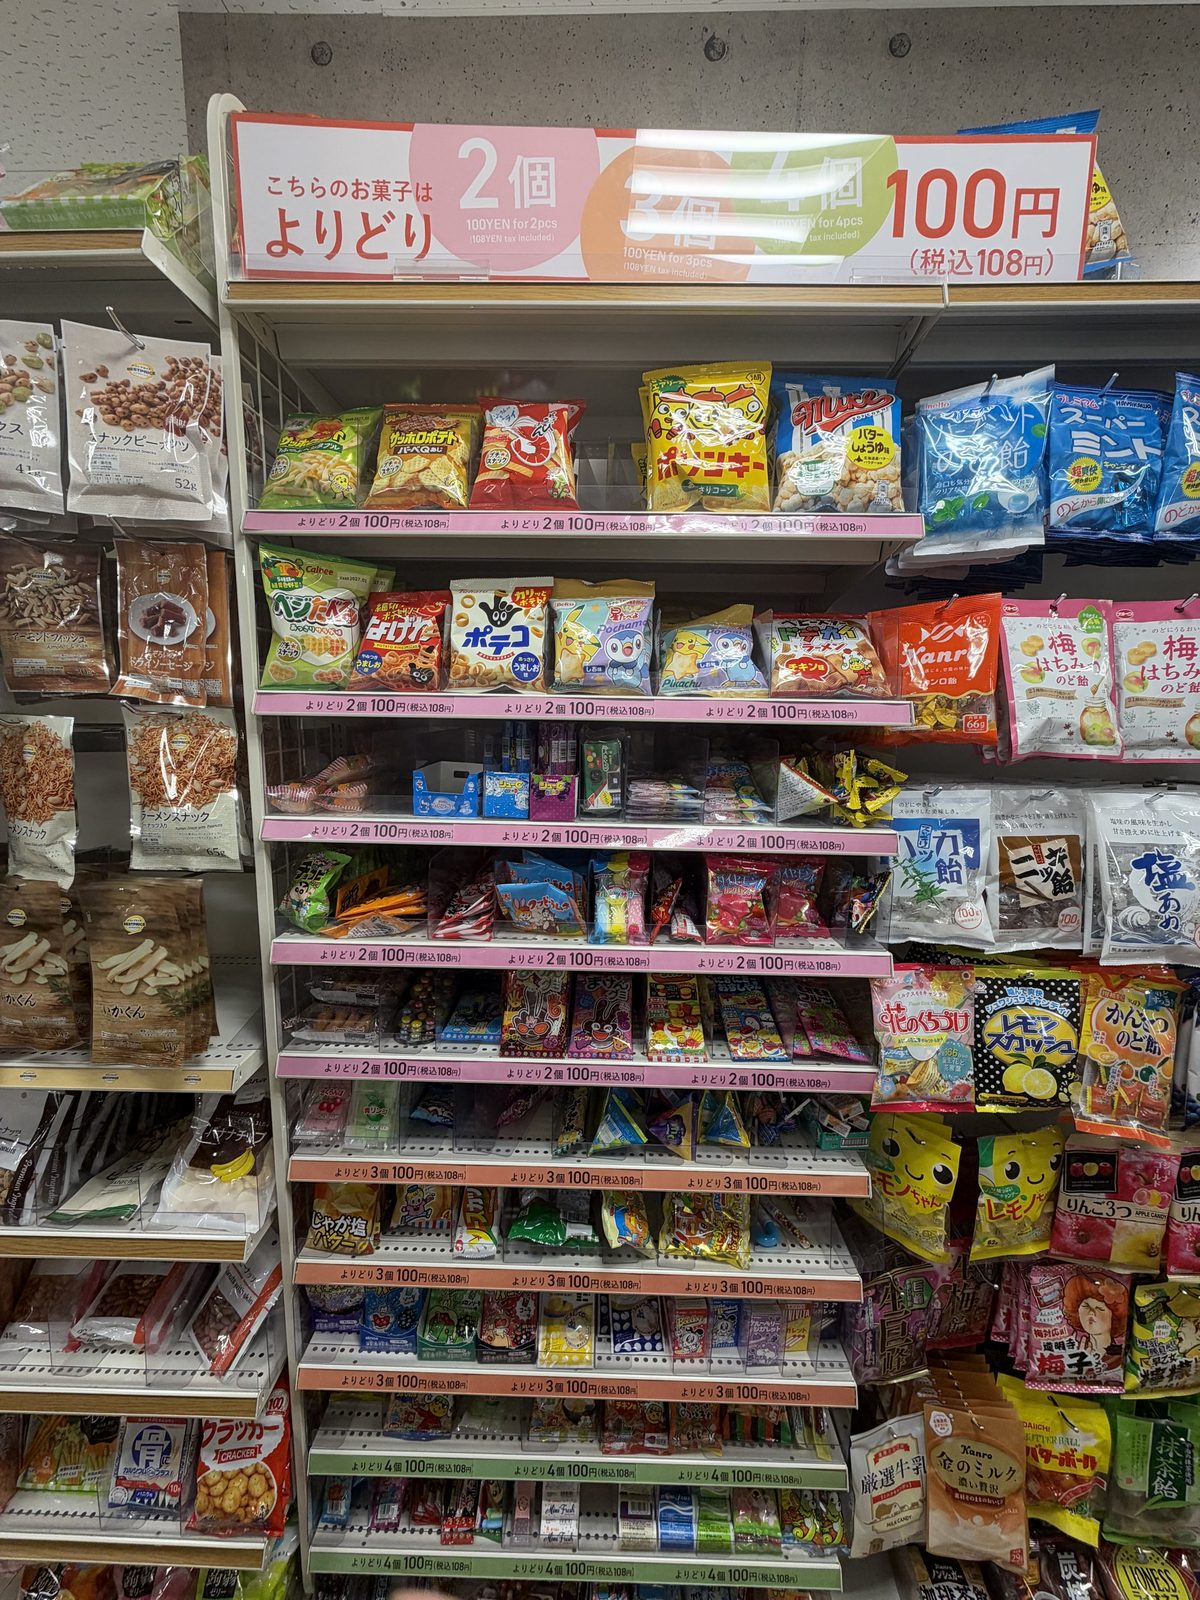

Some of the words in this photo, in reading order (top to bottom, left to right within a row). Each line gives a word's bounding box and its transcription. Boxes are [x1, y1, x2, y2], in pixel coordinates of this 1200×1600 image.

[457, 136, 558, 210] 2個
[266, 174, 433, 203] こちらのお菓子は
[620, 169, 722, 252] 3個
[885, 166, 1062, 240] 100円
[466, 218, 510, 232] 100YEN
[512, 217, 528, 230] for
[529, 217, 558, 231] 2pcs
[816, 216, 831, 229] for
[832, 214, 864, 229] 4pcs
[264, 206, 433, 262] よりどり
[503, 234, 516, 244] tax
[516, 233, 555, 245] included)
[825, 230, 861, 243] included)
[622, 246, 667, 262] 100YEN
[668, 249, 685, 264] for
[685, 252, 713, 269] 3pcs
[908, 247, 1056, 279] (税込108円)
[671, 264, 709, 279] included)
[1060, 407, 1146, 430] スーパー
[390, 431, 458, 449] サッポロポテト
[858, 428, 884, 440] バター
[1071, 430, 1162, 461] ミント
[174, 478, 197, 491] 52g
[297, 513, 450, 530] よりどり2個100円(税込108円)
[461, 625, 530, 656] ポテコ
[1048, 631, 1078, 656] 梅
[1162, 634, 1199, 662] 梅
[513, 662, 540, 673] うましお
[1056, 674, 1090, 687] のど飴
[305, 698, 455, 714] よりどり2個100円(税込108円)
[504, 701, 655, 717] よりどり2個100円(税込108円)
[705, 703, 857, 721] よりどり2個100円(税込108円)
[966, 720, 986, 730] 66g
[319, 948, 461, 963] よりどり2個100円(税込108円)
[508, 952, 650, 967] よりどり2個100円(税込108円)
[697, 955, 842, 972] よりどり2個100円(税込108円)
[102, 1004, 146, 1019] いかくん
[880, 1002, 971, 1034] 花のくちづけ
[1002, 1014, 1059, 1035] レモン
[985, 1034, 1078, 1054] スカッシュ
[324, 1061, 462, 1077] よりどり2個100円(税込108円)
[507, 1066, 645, 1083] よりどり2個100円(税込108円)
[691, 1072, 831, 1090] よりどり2個100円(税込108円)
[334, 1166, 467, 1181] よりどり3個100円(税込108円)
[511, 1170, 643, 1187] よりどり3個100円(税込108円)
[687, 1175, 822, 1192] よりどり3個100円(税込108円)
[1066, 1198, 1133, 1219] りんご3つ
[311, 1211, 368, 1238] じゃが塩
[313, 1231, 356, 1249] バター
[340, 1267, 469, 1285] よりどり3個100円(税込108円)
[512, 1274, 641, 1290] よりどり3個100円(税込108円)
[684, 1279, 816, 1296] よりどり3個100円(税込108円)
[1036, 1353, 1093, 1376] 梅子
[341, 1374, 468, 1390] よりどり3個100円(税込108円)
[511, 1380, 638, 1396] よりどり3個100円(税込108円)
[681, 1385, 811, 1401] よりどり3個100円(税込108円)
[201, 1417, 280, 1449] クラッカー
[220, 1448, 257, 1462] CRACKER
[960, 1444, 993, 1460] Kanro
[351, 1459, 473, 1475] よりどり4個100円(税込108円)
[860, 1455, 927, 1495] 厳選牛乳
[936, 1452, 1018, 1482] 金のミルク
[678, 1468, 803, 1485] よりどり4個100円(税込108円)
[957, 1479, 1000, 1495] 濃い贅沢
[351, 1556, 473, 1572] よりどり4個100円(税込108円)
[513, 1562, 635, 1578] よりどり4個100円(税込108円)
[674, 1568, 798, 1584] よりどり4個100円(税込108円)
[1122, 1564, 1180, 1594] LIONESS
